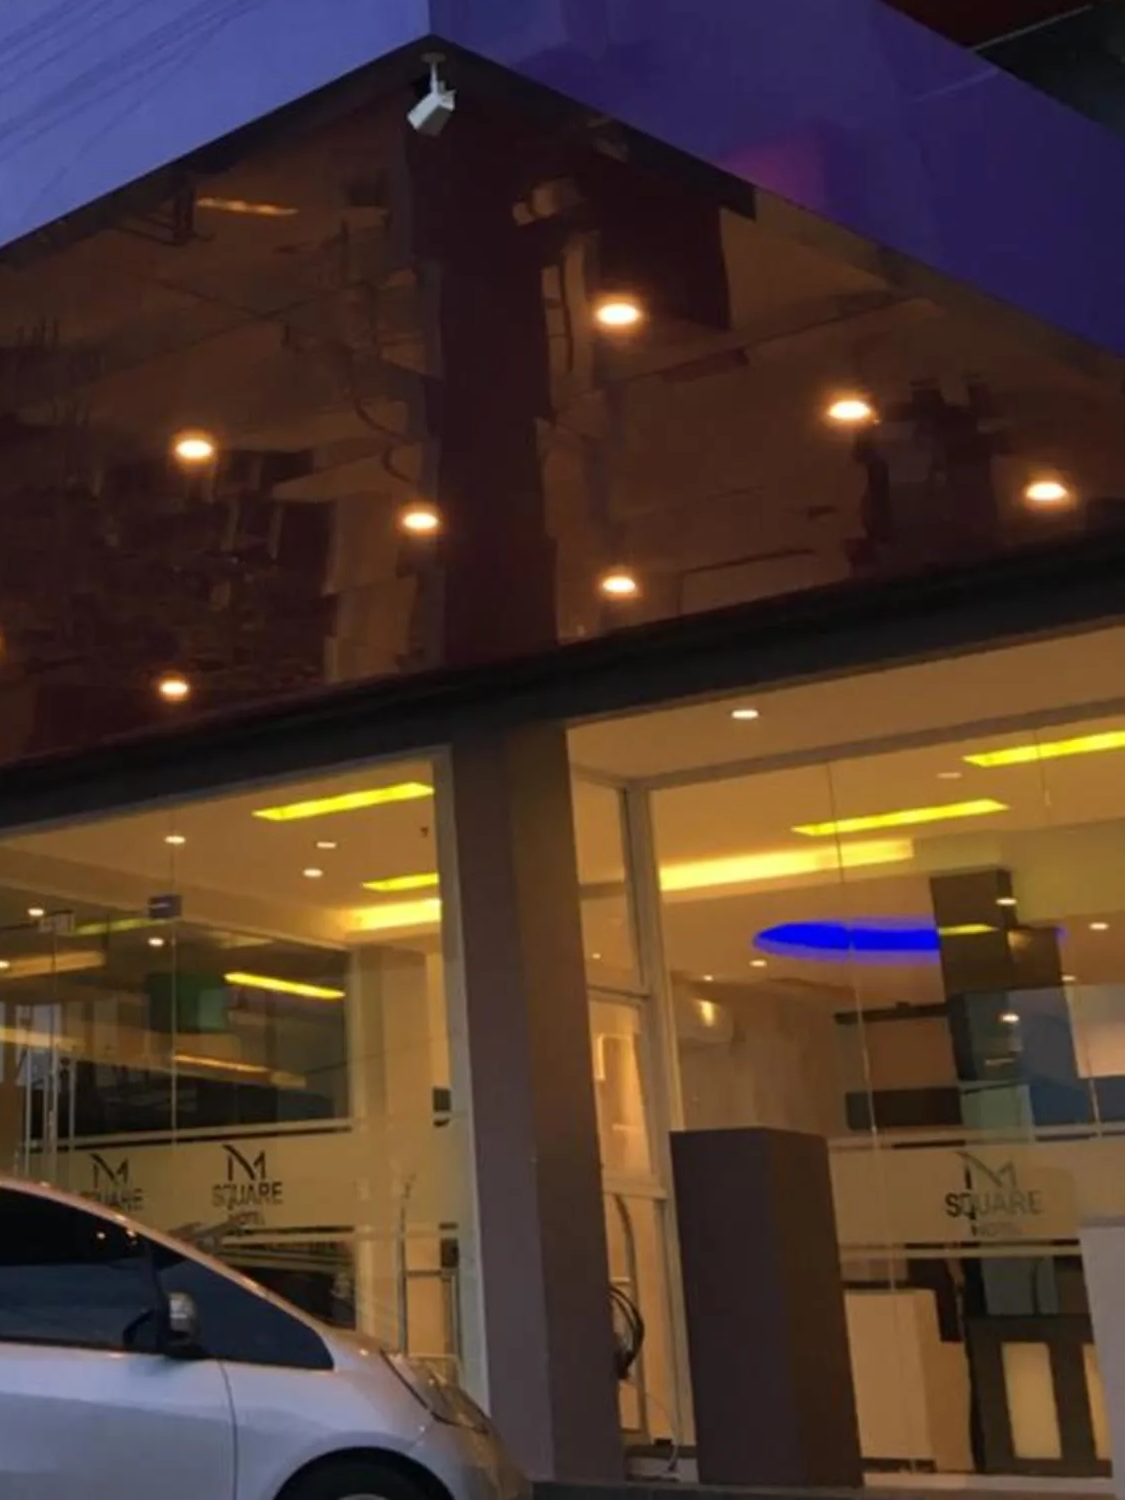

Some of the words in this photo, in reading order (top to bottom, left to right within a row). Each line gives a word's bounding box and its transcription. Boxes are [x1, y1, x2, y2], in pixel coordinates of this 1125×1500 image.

[90, 1153, 129, 1189] M
[223, 1144, 266, 1181] M
[954, 1151, 1016, 1189] M
[212, 1182, 283, 1210] SQUARE
[945, 1190, 1044, 1219] SQUARE
